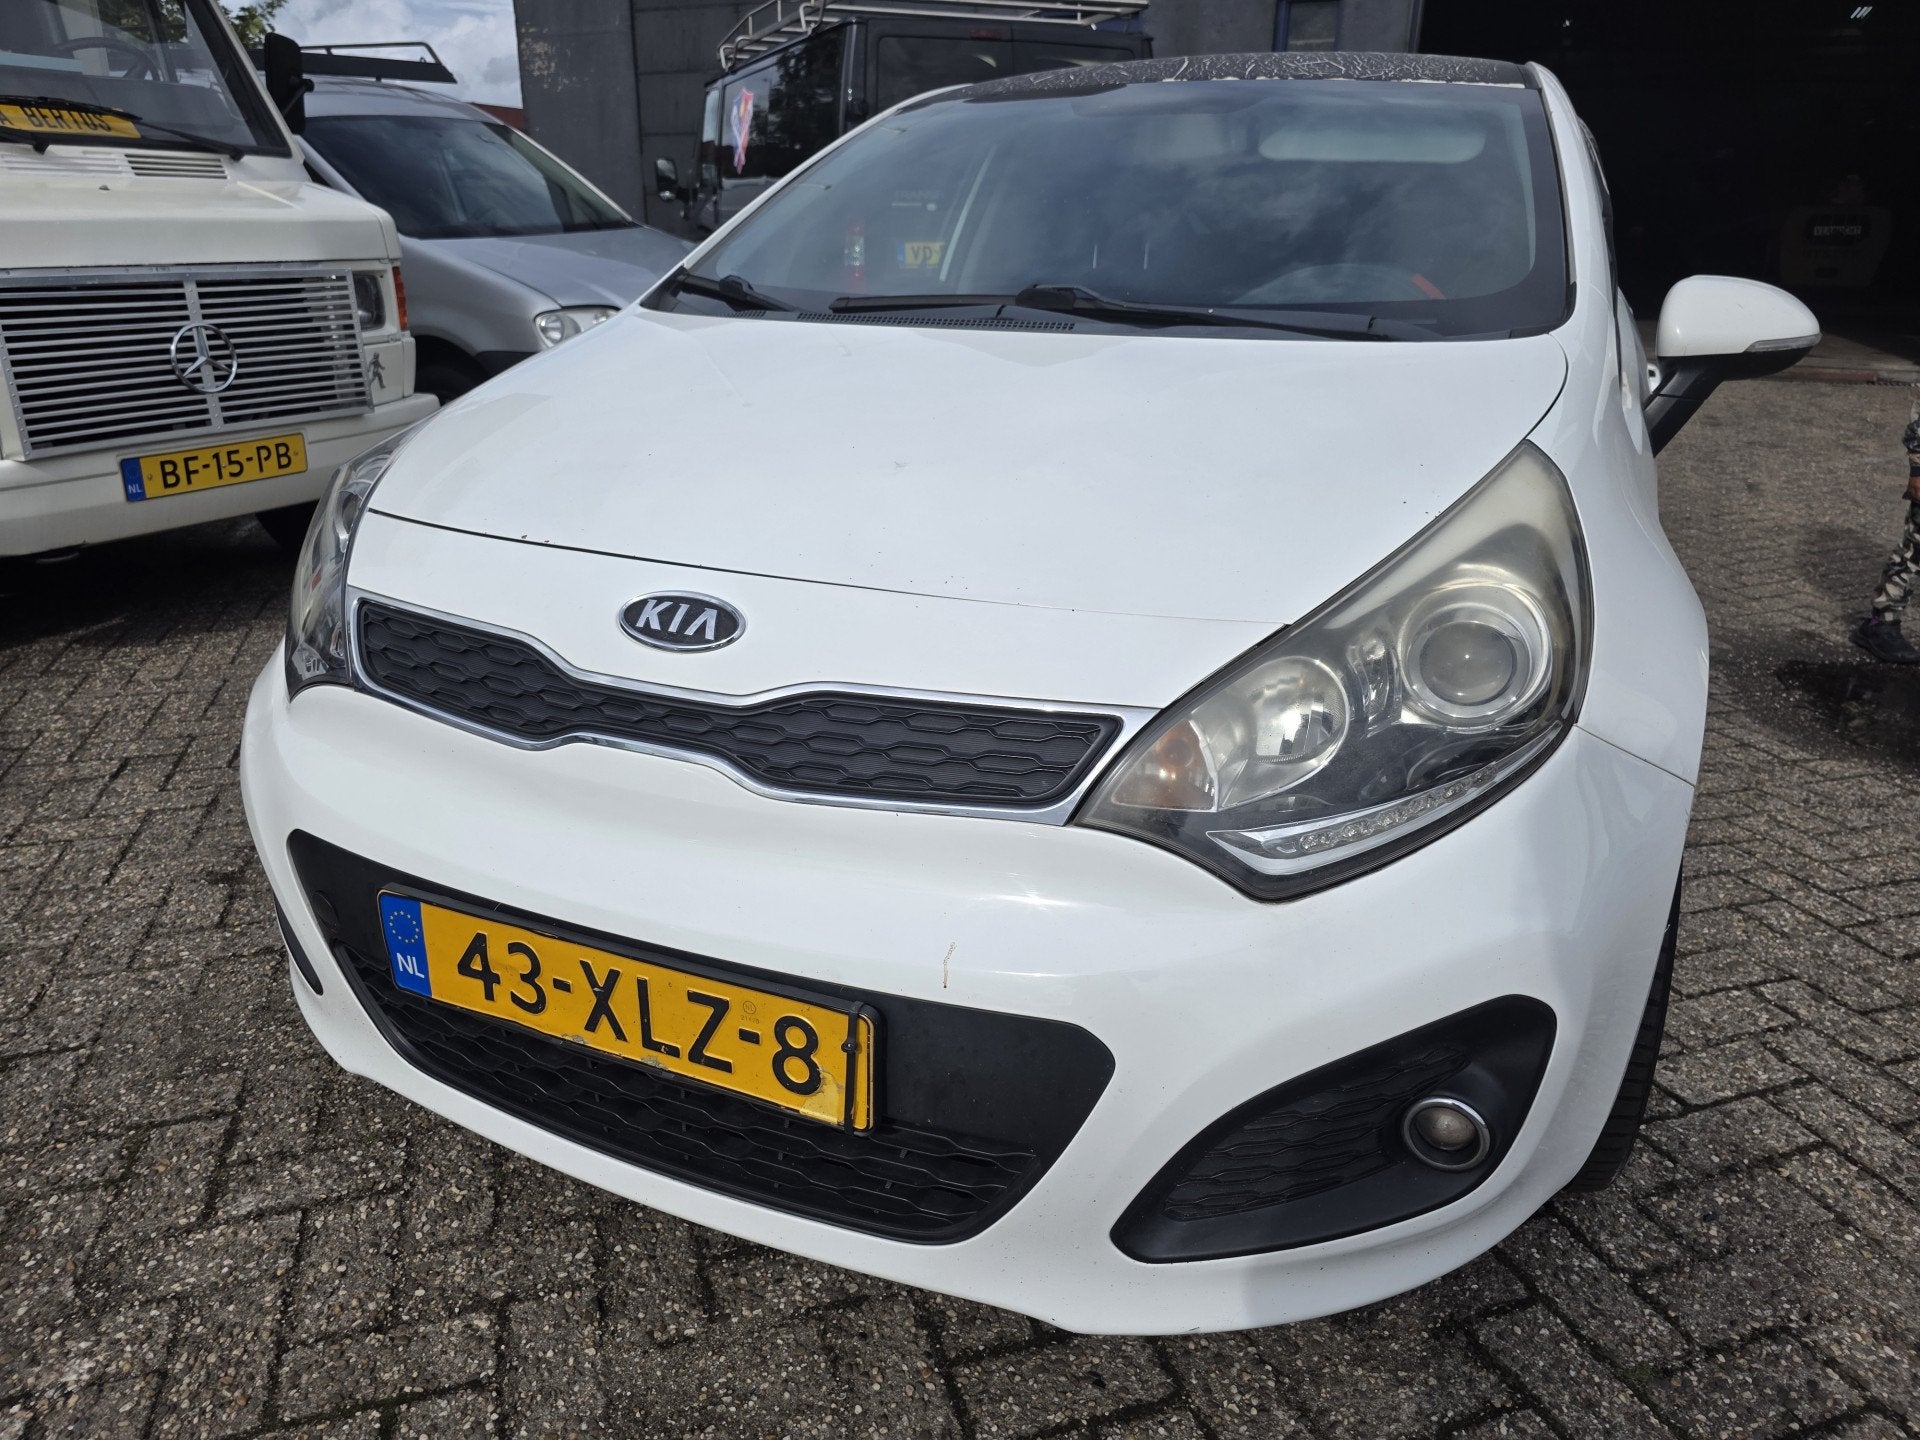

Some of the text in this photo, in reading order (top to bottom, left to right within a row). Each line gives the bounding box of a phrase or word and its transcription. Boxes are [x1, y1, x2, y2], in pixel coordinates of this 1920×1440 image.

[20, 104, 111, 132] BERTUS
[159, 442, 292, 489] BF-15-PB
[128, 482, 142, 493] NL
[635, 598, 718, 640] KIA
[396, 951, 425, 980] NL
[457, 931, 822, 1096] 43-XLZ-8
